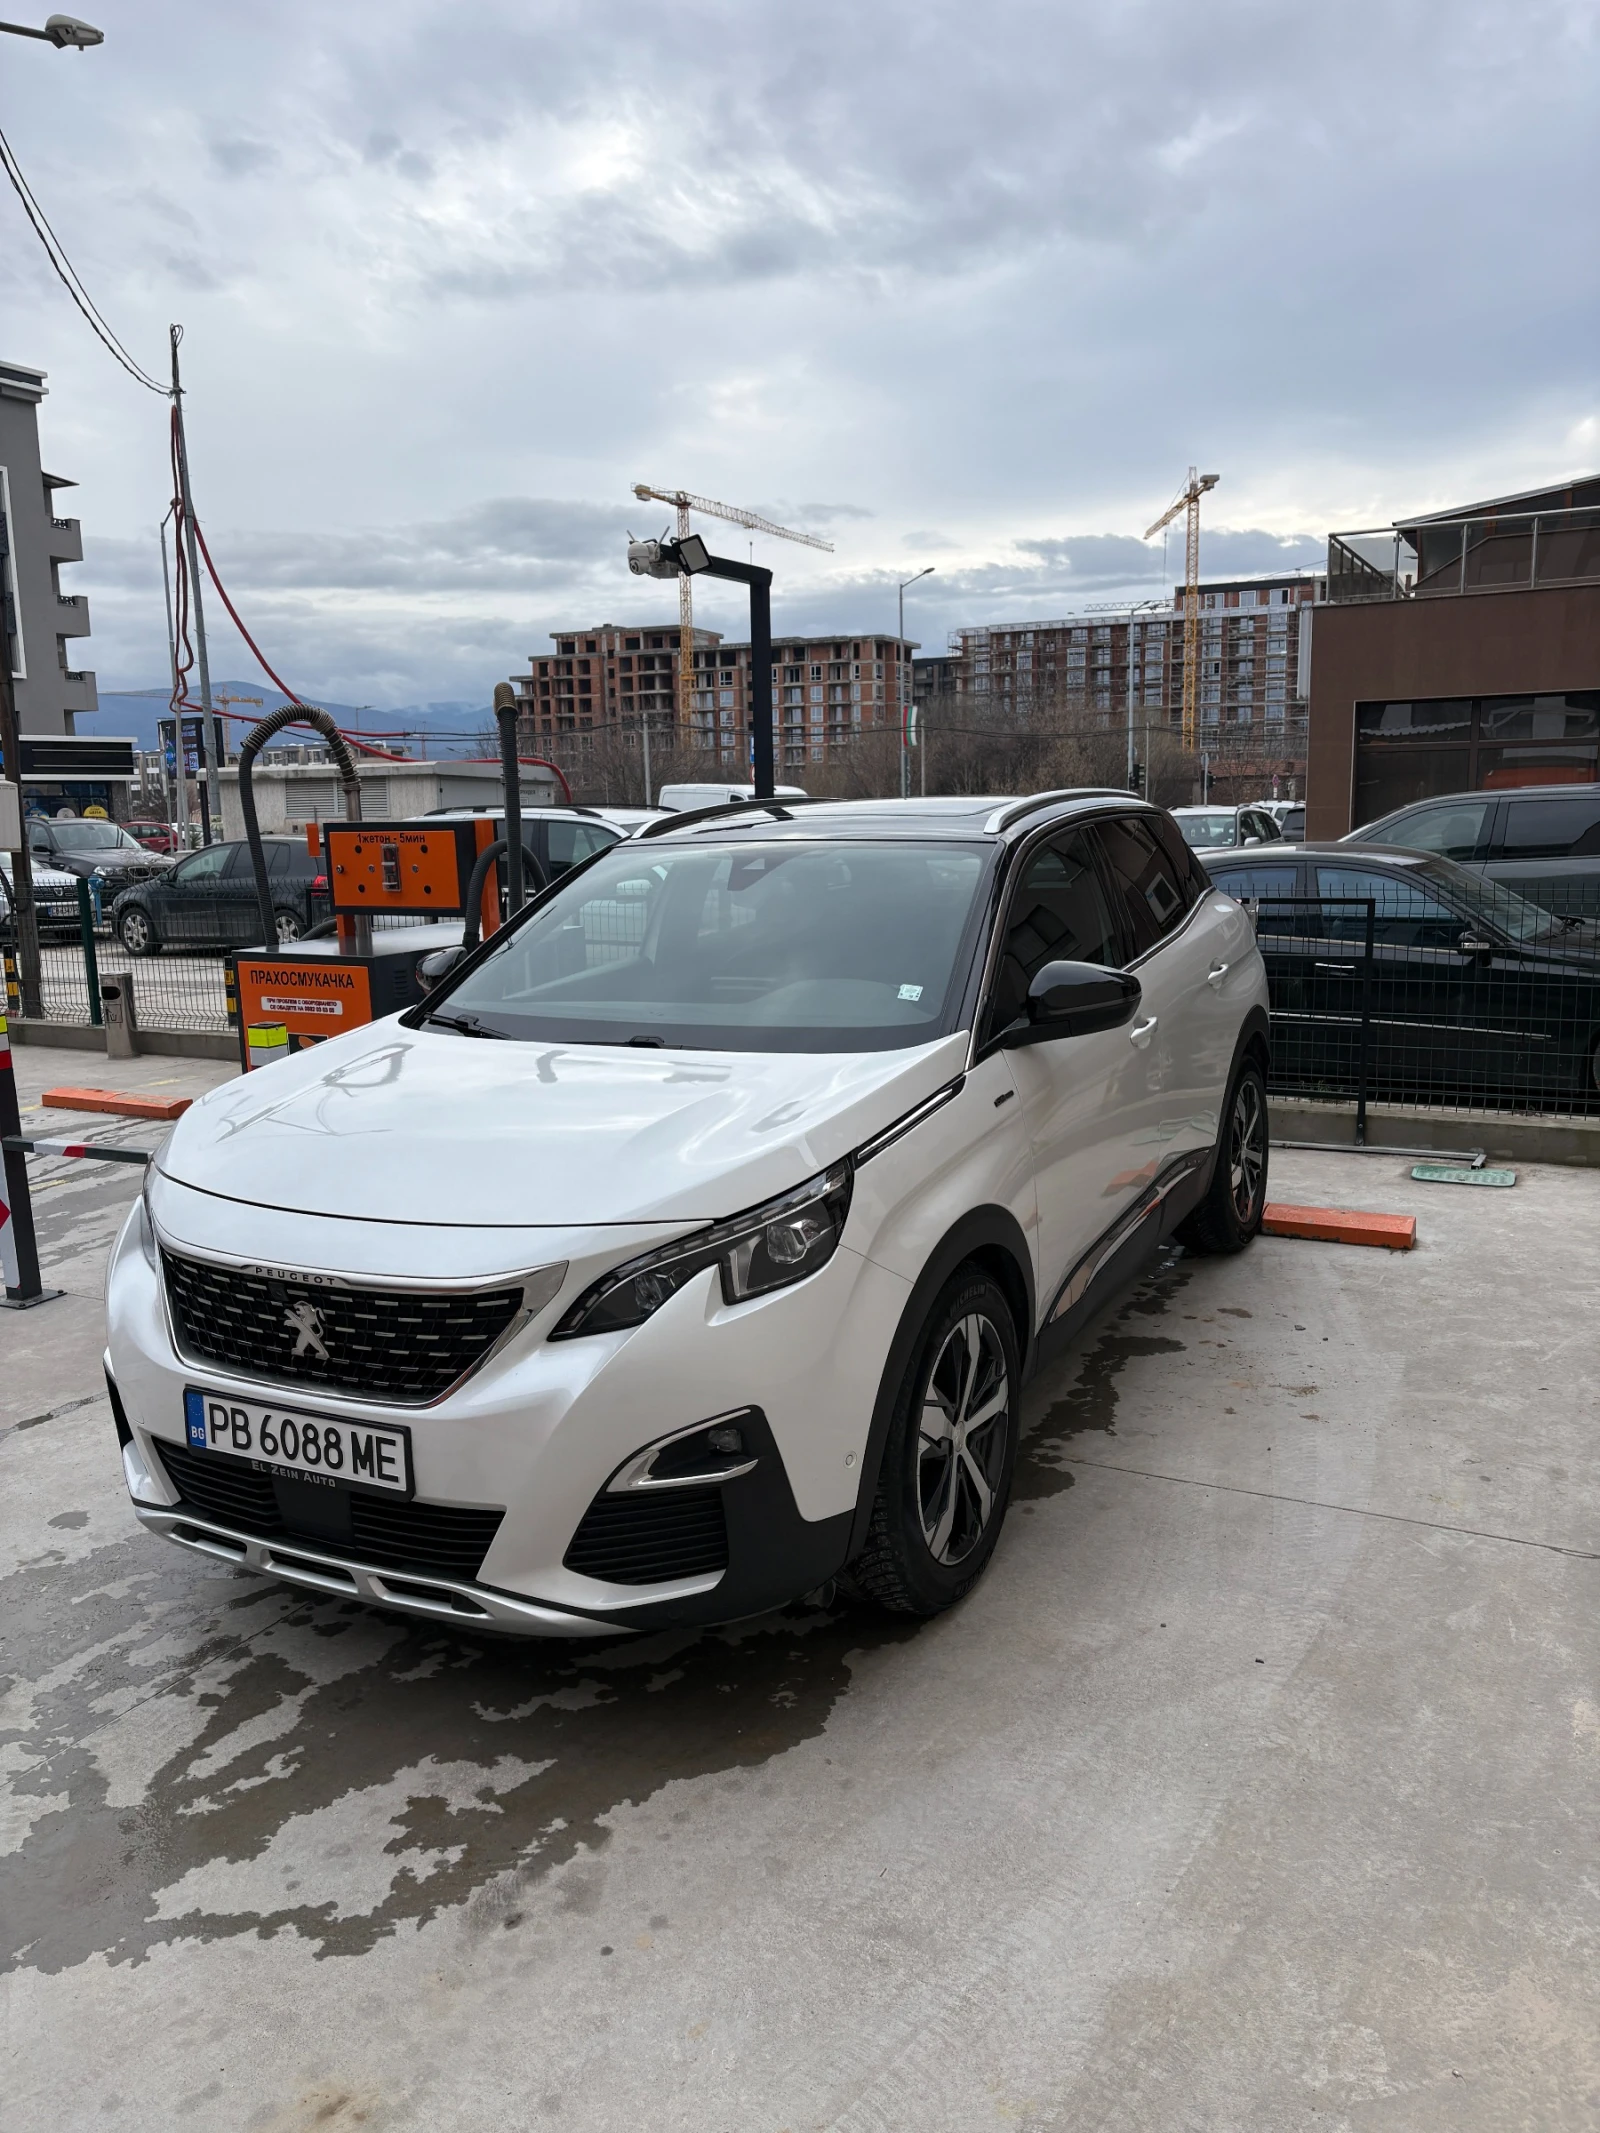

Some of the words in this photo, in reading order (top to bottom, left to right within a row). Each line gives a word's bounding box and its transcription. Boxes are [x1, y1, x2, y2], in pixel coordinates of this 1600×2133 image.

[357, 832, 391, 844] 1жетон
[400, 832, 426, 843] 5мин
[250, 970, 355, 989] ПРАХОСМУКАЧКА
[255, 1266, 335, 1286] PEUGEOT
[191, 1426, 205, 1440] BG
[208, 1403, 252, 1451] PB
[259, 1415, 344, 1470] 6088
[350, 1431, 399, 1483] ME
[251, 1460, 267, 1473] EL
[270, 1464, 299, 1480] ZEIN
[303, 1471, 336, 1488] AUTO
